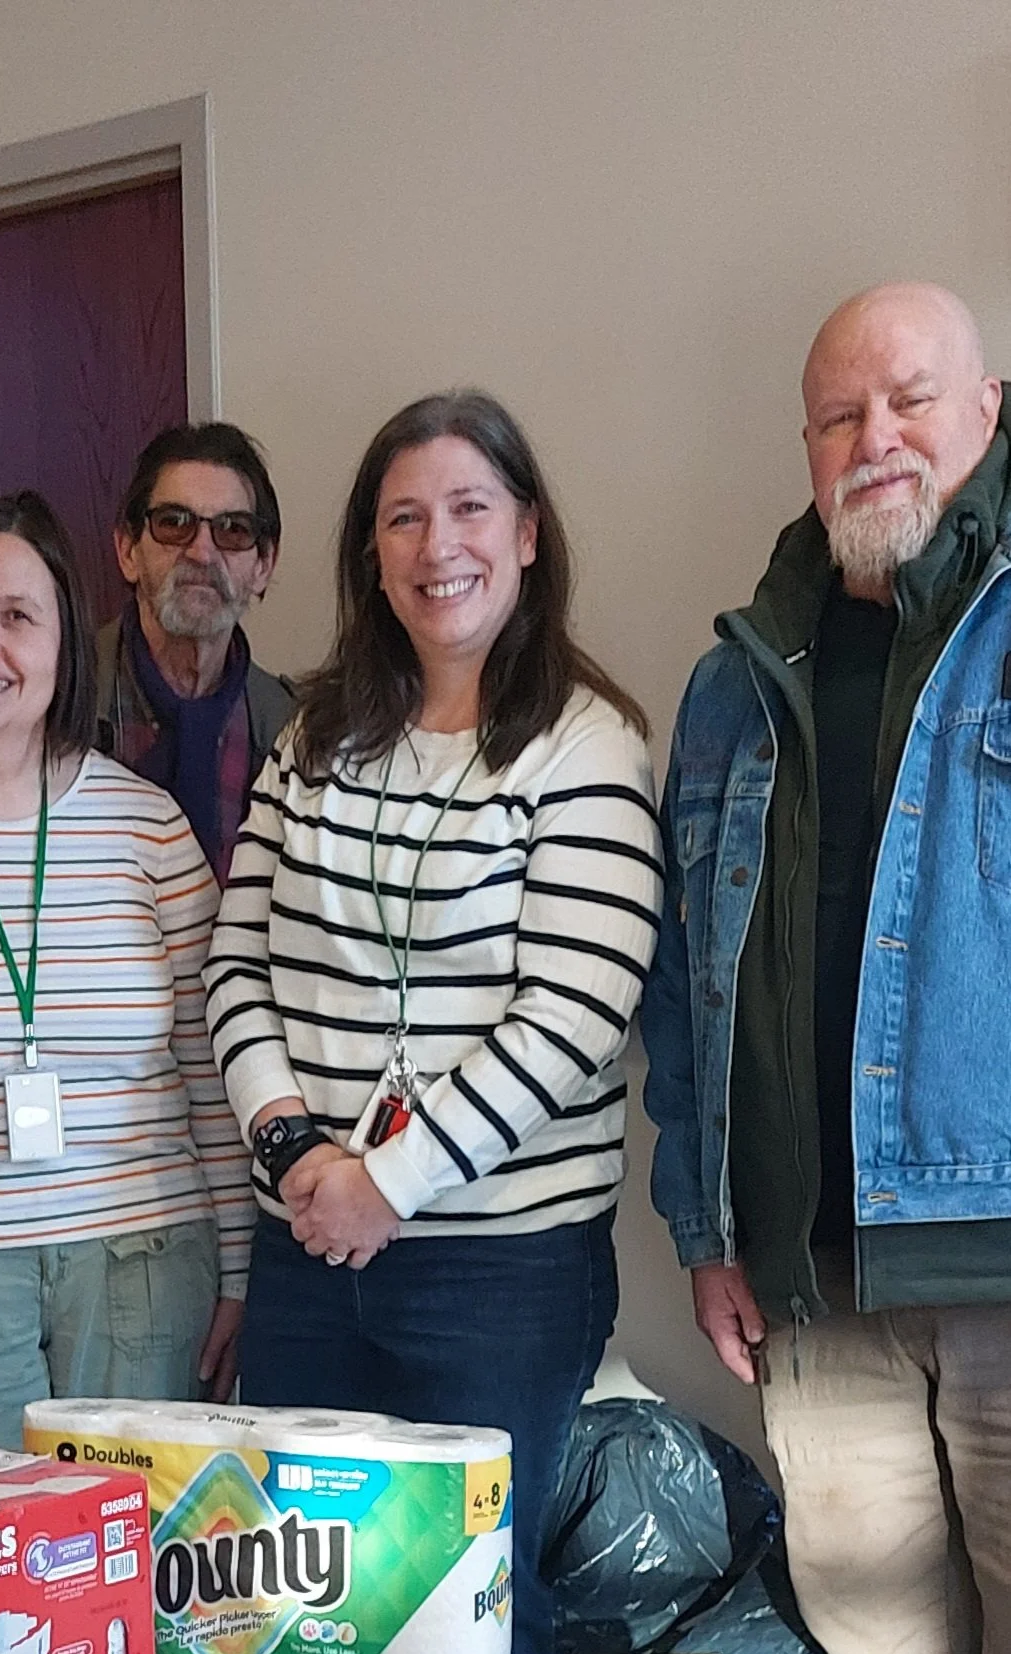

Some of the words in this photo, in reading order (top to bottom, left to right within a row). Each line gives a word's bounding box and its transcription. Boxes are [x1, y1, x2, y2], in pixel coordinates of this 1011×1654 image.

[83, 1444, 153, 1469] Doubles
[473, 1493, 483, 1510] 4
[491, 1483, 500, 1507] 8
[156, 1514, 345, 1614] ounty
[176, 1617, 217, 1636] Quicker
[219, 1609, 249, 1629] Picker
